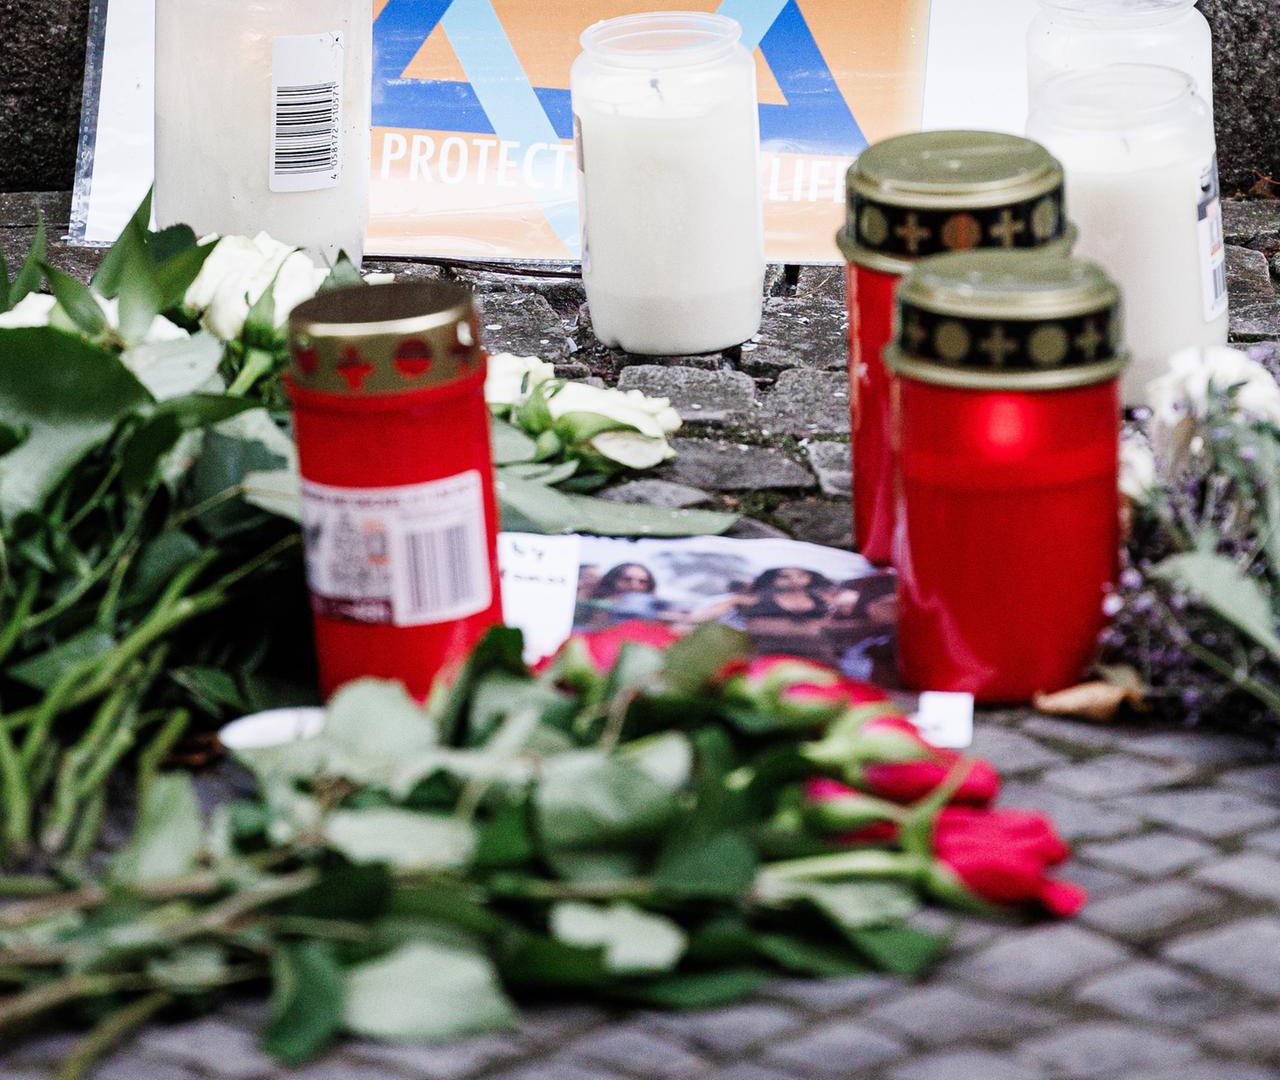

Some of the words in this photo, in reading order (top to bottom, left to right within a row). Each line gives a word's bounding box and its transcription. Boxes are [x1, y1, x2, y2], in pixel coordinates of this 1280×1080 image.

[331, 85, 340, 123] 510571
[331, 127, 339, 166] 058172
[380, 131, 575, 190] PROTECT
